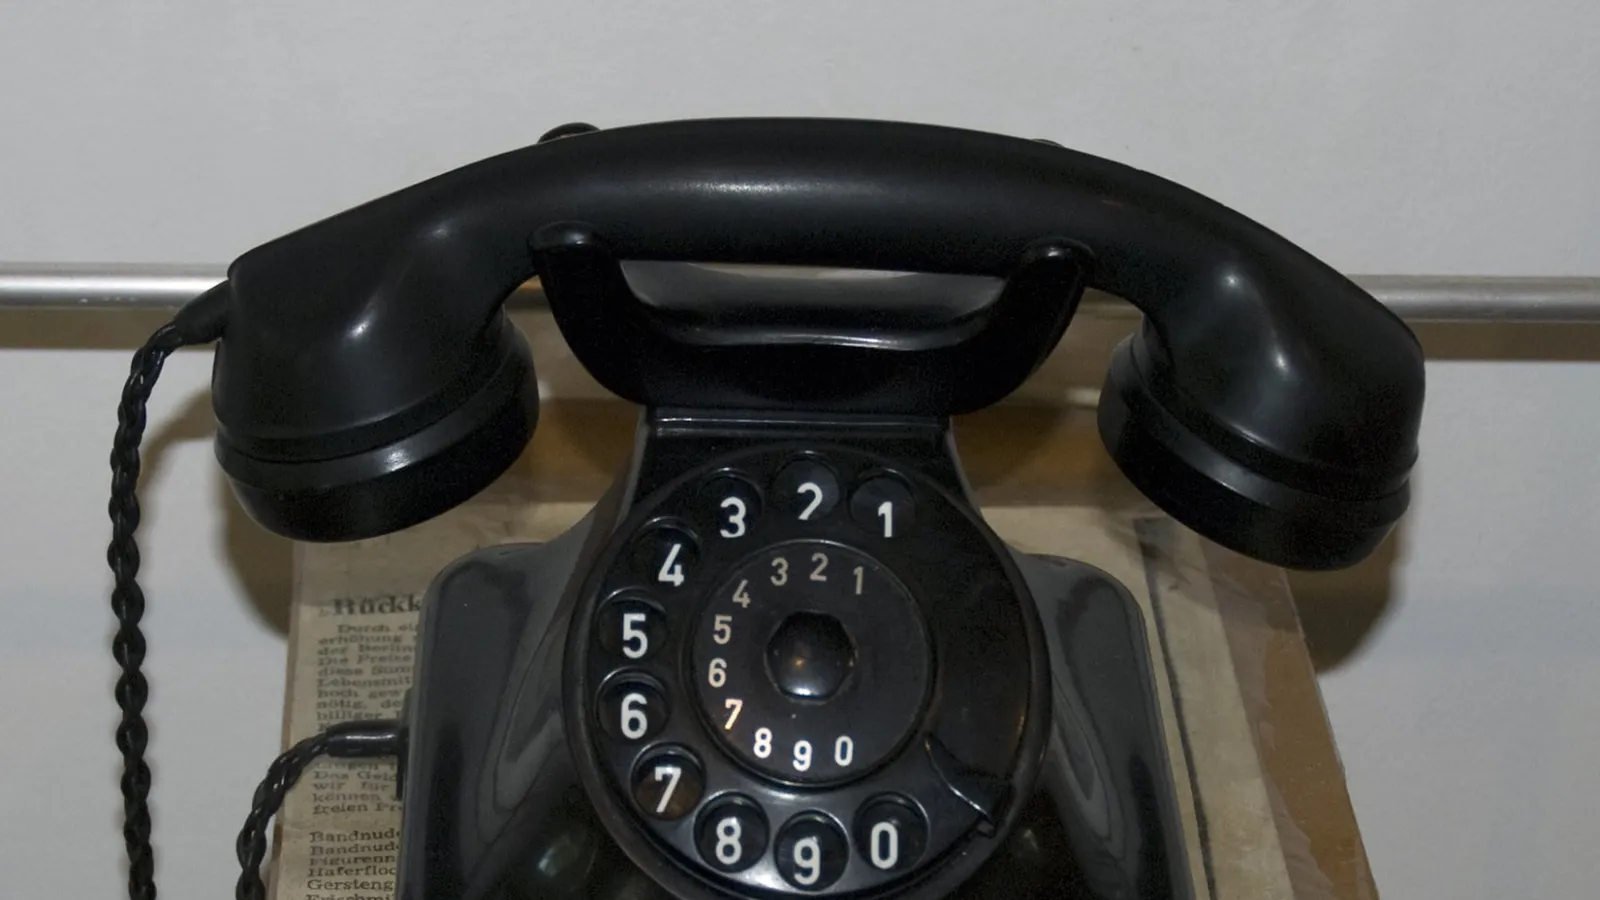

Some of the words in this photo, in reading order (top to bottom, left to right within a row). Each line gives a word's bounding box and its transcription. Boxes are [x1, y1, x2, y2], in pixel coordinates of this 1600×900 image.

[797, 482, 823, 520] 2
[720, 496, 746, 538] 3
[877, 501, 893, 538] 1
[658, 543, 685, 587] 4
[770, 557, 789, 586] 3
[809, 552, 829, 582] 2
[853, 566, 864, 595] 1
[732, 579, 751, 609] 4
[318, 635, 402, 646] erhöhung
[337, 624, 391, 634] Durch
[622, 613, 648, 659] 5
[712, 614, 733, 645] 5
[317, 647, 348, 656] der
[317, 657, 348, 667] Die
[357, 653, 412, 665] Preise
[317, 667, 363, 677] diese
[707, 657, 728, 689] 6
[317, 689, 358, 699] hoch
[316, 711, 382, 721] billiger
[620, 692, 648, 739] 6
[724, 697, 744, 731] 7
[752, 726, 773, 760] 8
[791, 739, 813, 773] 9
[833, 735, 854, 767] 0
[312, 770, 349, 780] Das
[312, 780, 346, 791] wir
[361, 780, 390, 792] für
[654, 765, 682, 813] 7
[312, 792, 381, 803] können
[715, 816, 742, 865] 8
[870, 821, 898, 869] 0
[793, 836, 821, 886] 9
[306, 879, 394, 892] Gersteng
